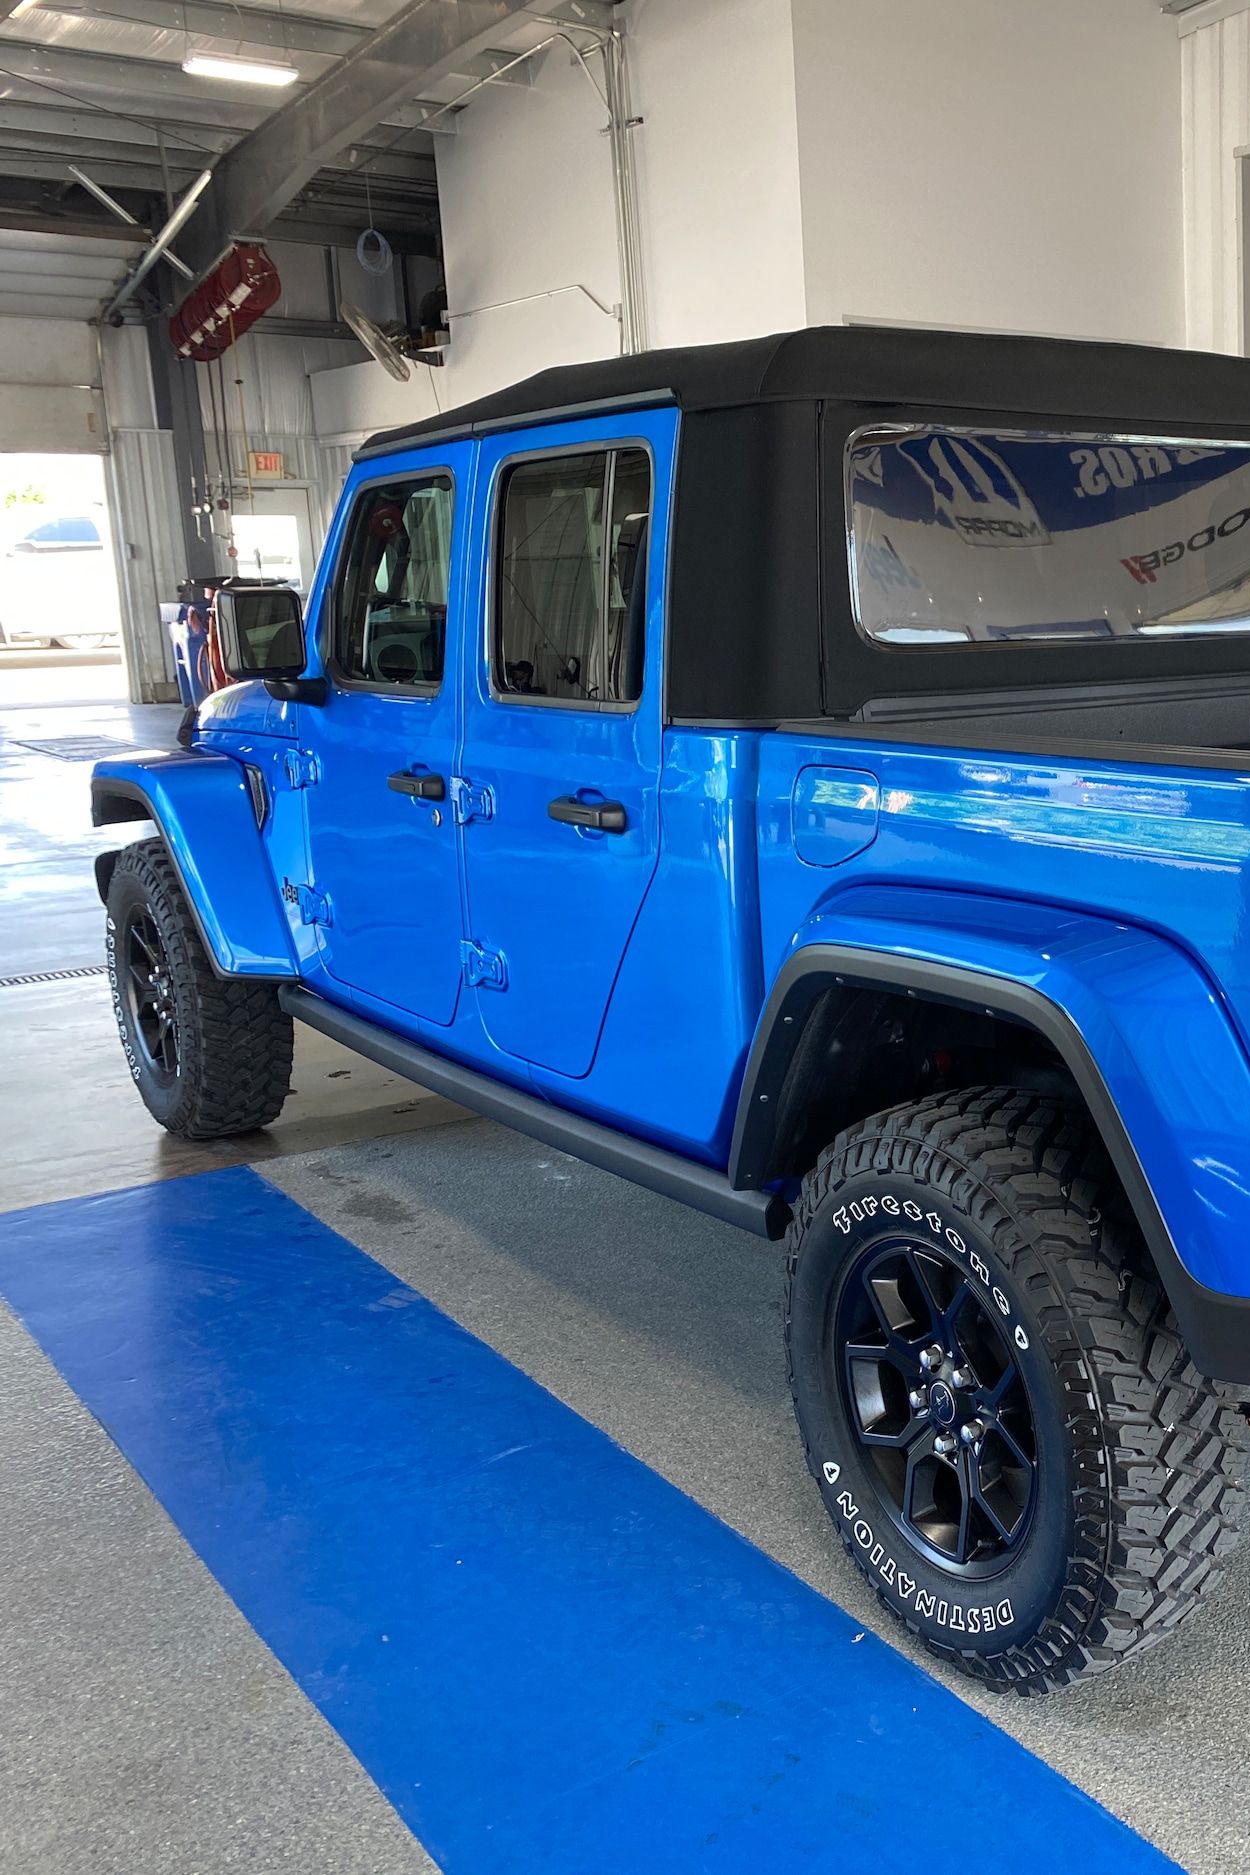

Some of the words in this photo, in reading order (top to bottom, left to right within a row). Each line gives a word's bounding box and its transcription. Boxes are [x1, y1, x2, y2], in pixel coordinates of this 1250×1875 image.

[256, 454, 279, 471] EXIT
[833, 1195, 1011, 1316] Firestone
[836, 1490, 1015, 1634] DESTINATION
